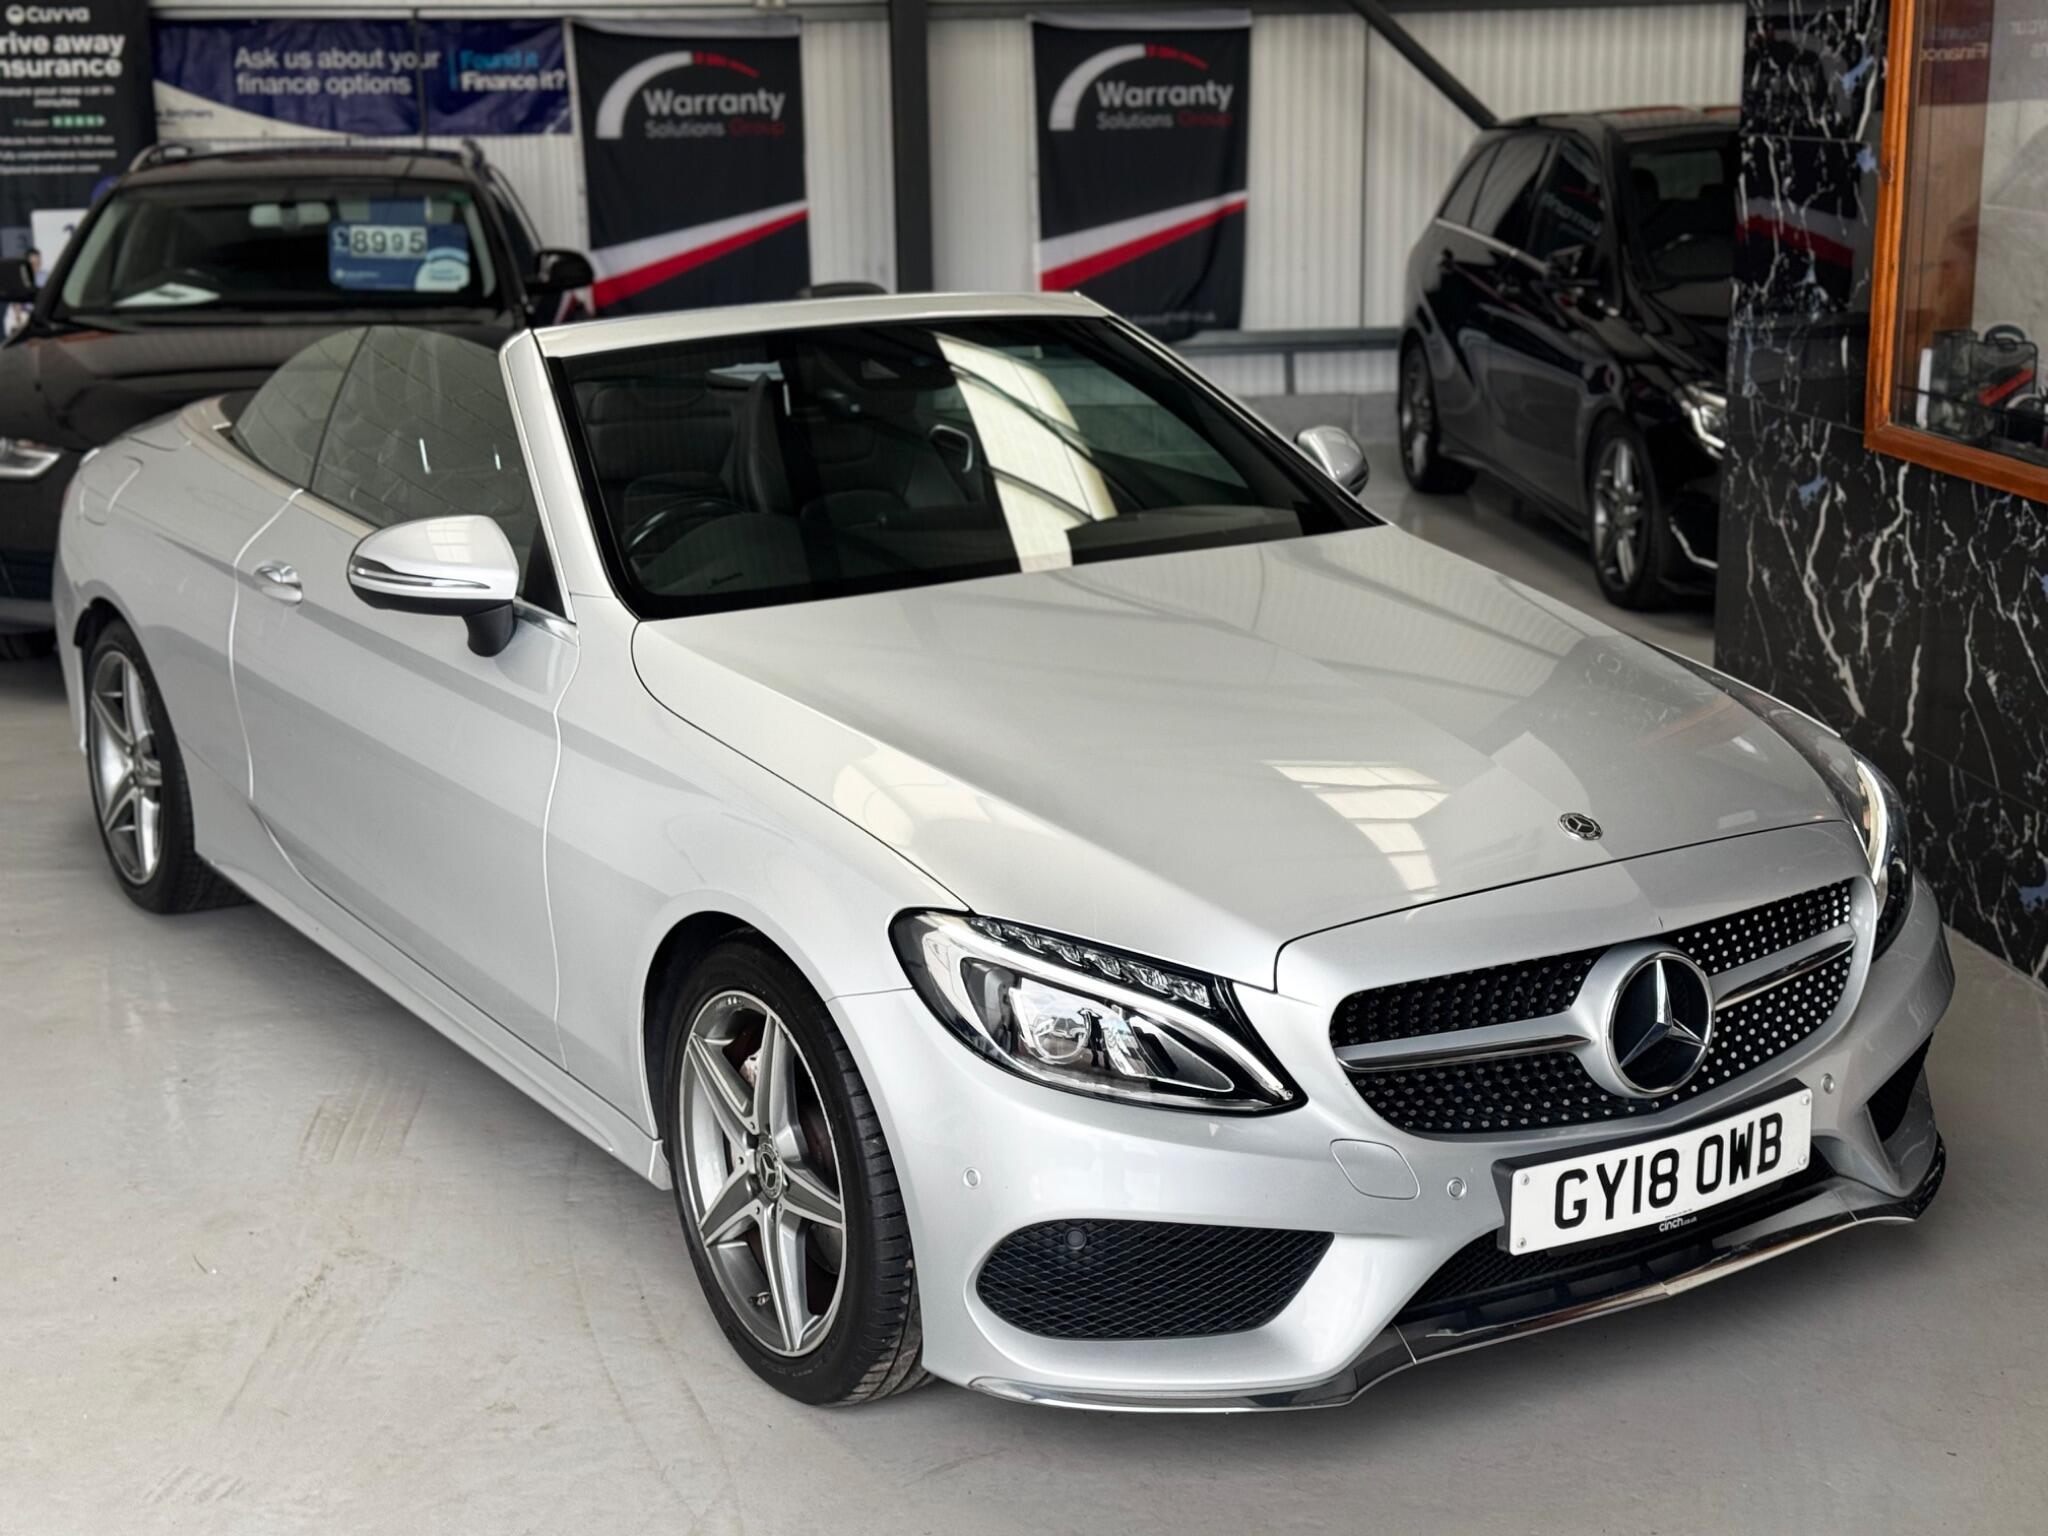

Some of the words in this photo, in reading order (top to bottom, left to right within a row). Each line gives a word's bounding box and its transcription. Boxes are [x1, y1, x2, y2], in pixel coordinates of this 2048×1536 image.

[53, 34, 126, 58] away
[234, 46, 279, 69] Ask
[283, 51, 313, 69] us
[317, 48, 385, 69] about
[388, 50, 442, 74] your
[460, 49, 522, 69] Found
[525, 49, 540, 69] it
[236, 73, 320, 95] finance
[324, 73, 412, 99] options
[460, 70, 538, 91] Finance
[540, 69, 566, 90] it?
[642, 88, 786, 122] Warranty
[1095, 80, 1234, 113] Warranty
[644, 119, 726, 139] Solutions
[1096, 111, 1174, 130] Solutions
[1554, 1148, 1680, 1230] GY18
[1696, 1112, 1784, 1195] OWB
